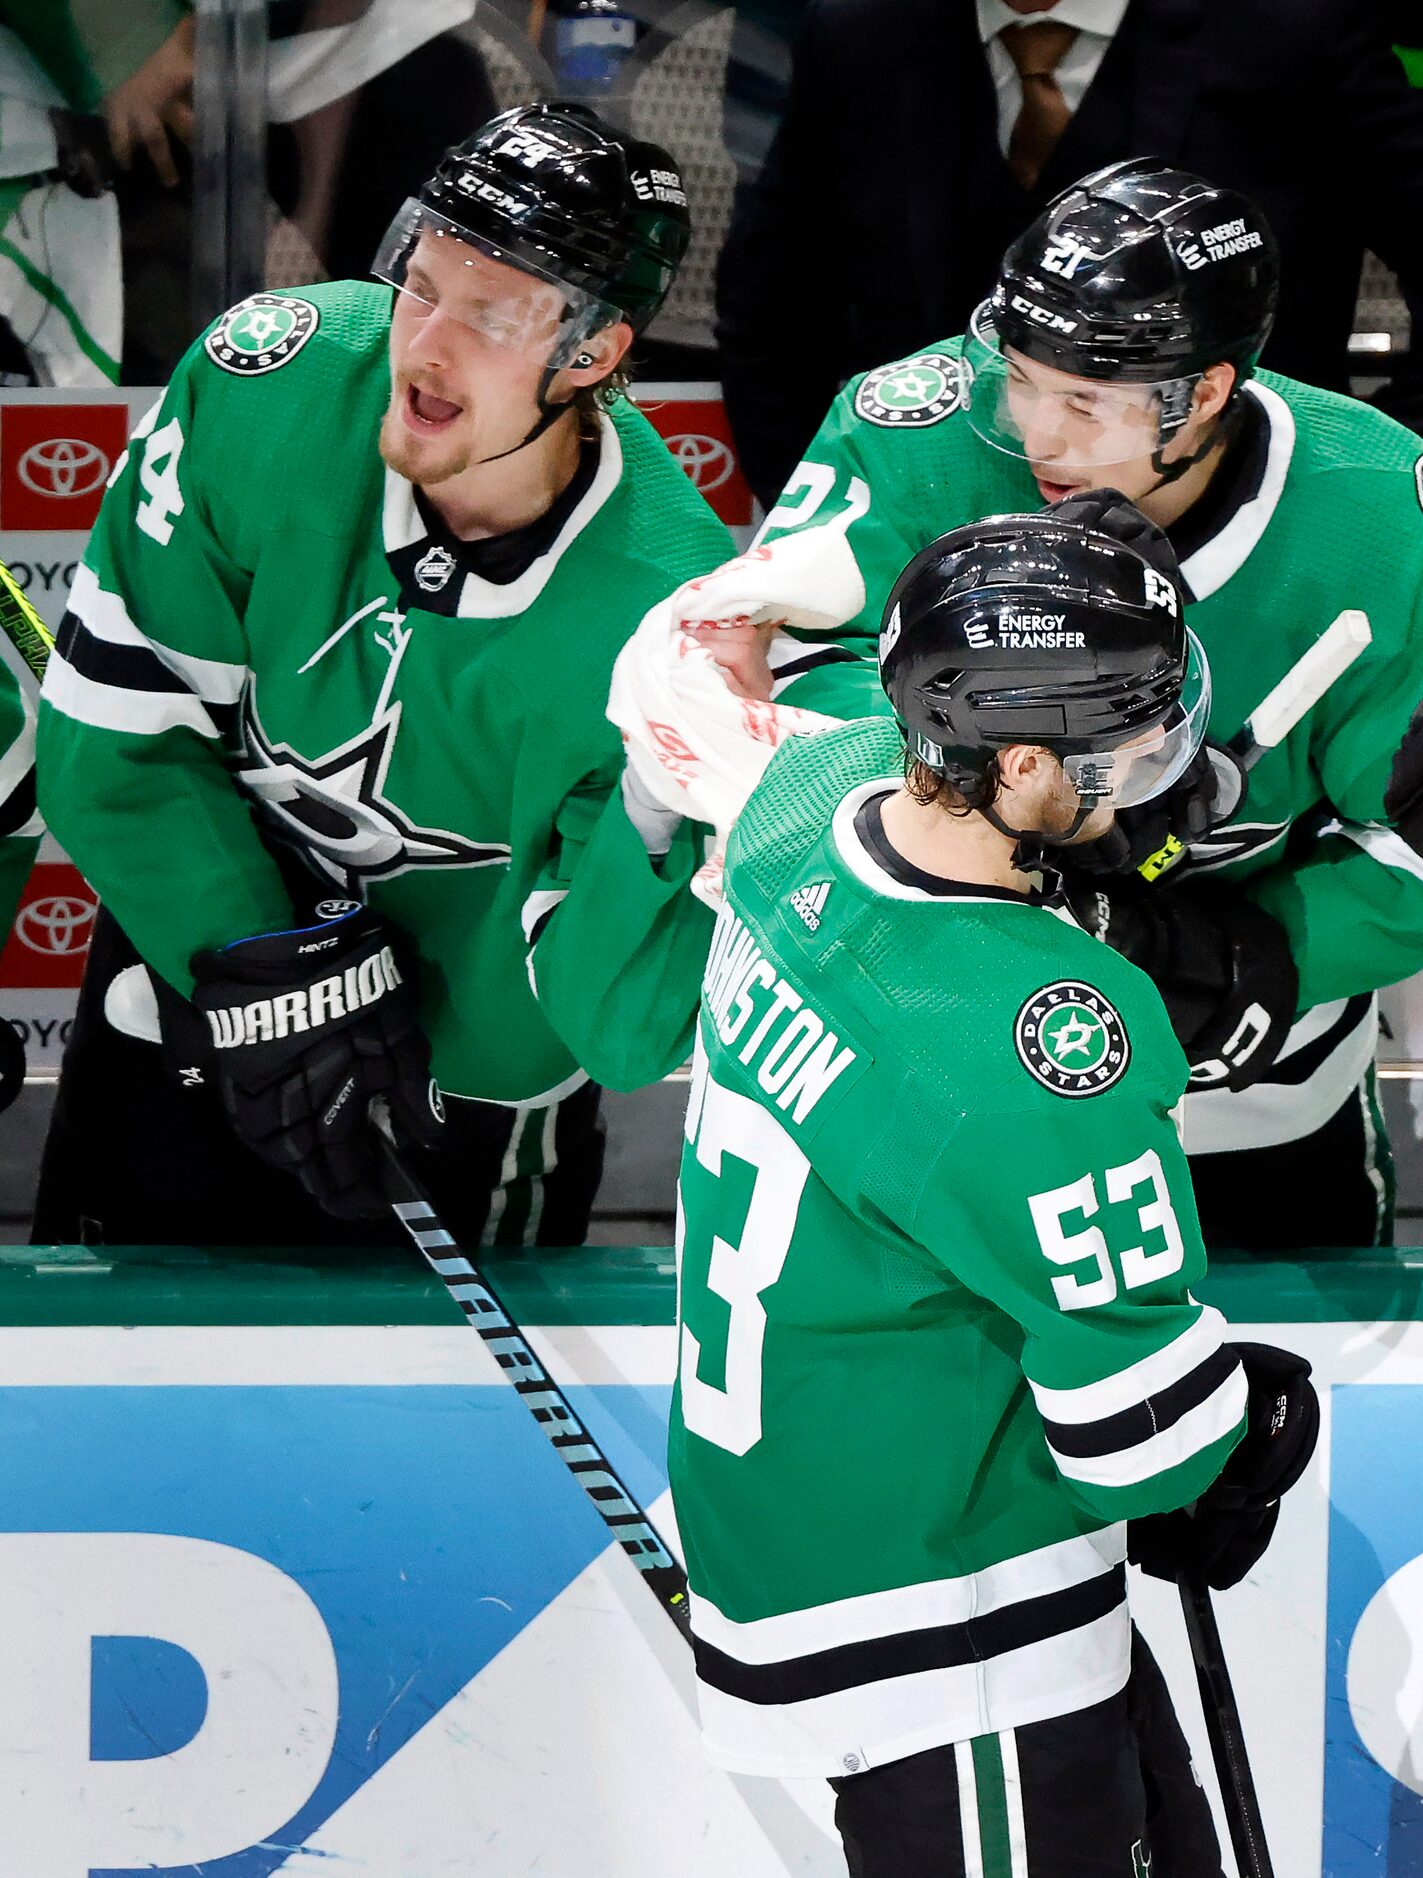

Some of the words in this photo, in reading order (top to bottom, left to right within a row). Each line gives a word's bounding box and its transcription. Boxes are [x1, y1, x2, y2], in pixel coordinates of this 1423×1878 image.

[457, 172, 530, 214] CCM
[1201, 218, 1246, 246] ENERGY
[1205, 231, 1263, 262] TRANSFER
[1011, 294, 1078, 334] CCM
[106, 385, 186, 546] 4
[999, 614, 1066, 631] ENERGY
[999, 632, 1086, 649] TRANSFER
[206, 945, 403, 1049] WARRIOR
[1023, 988, 1115, 1037] DALLAS
[1038, 1050, 1121, 1088] STARS
[1027, 1148, 1184, 1311] 53
